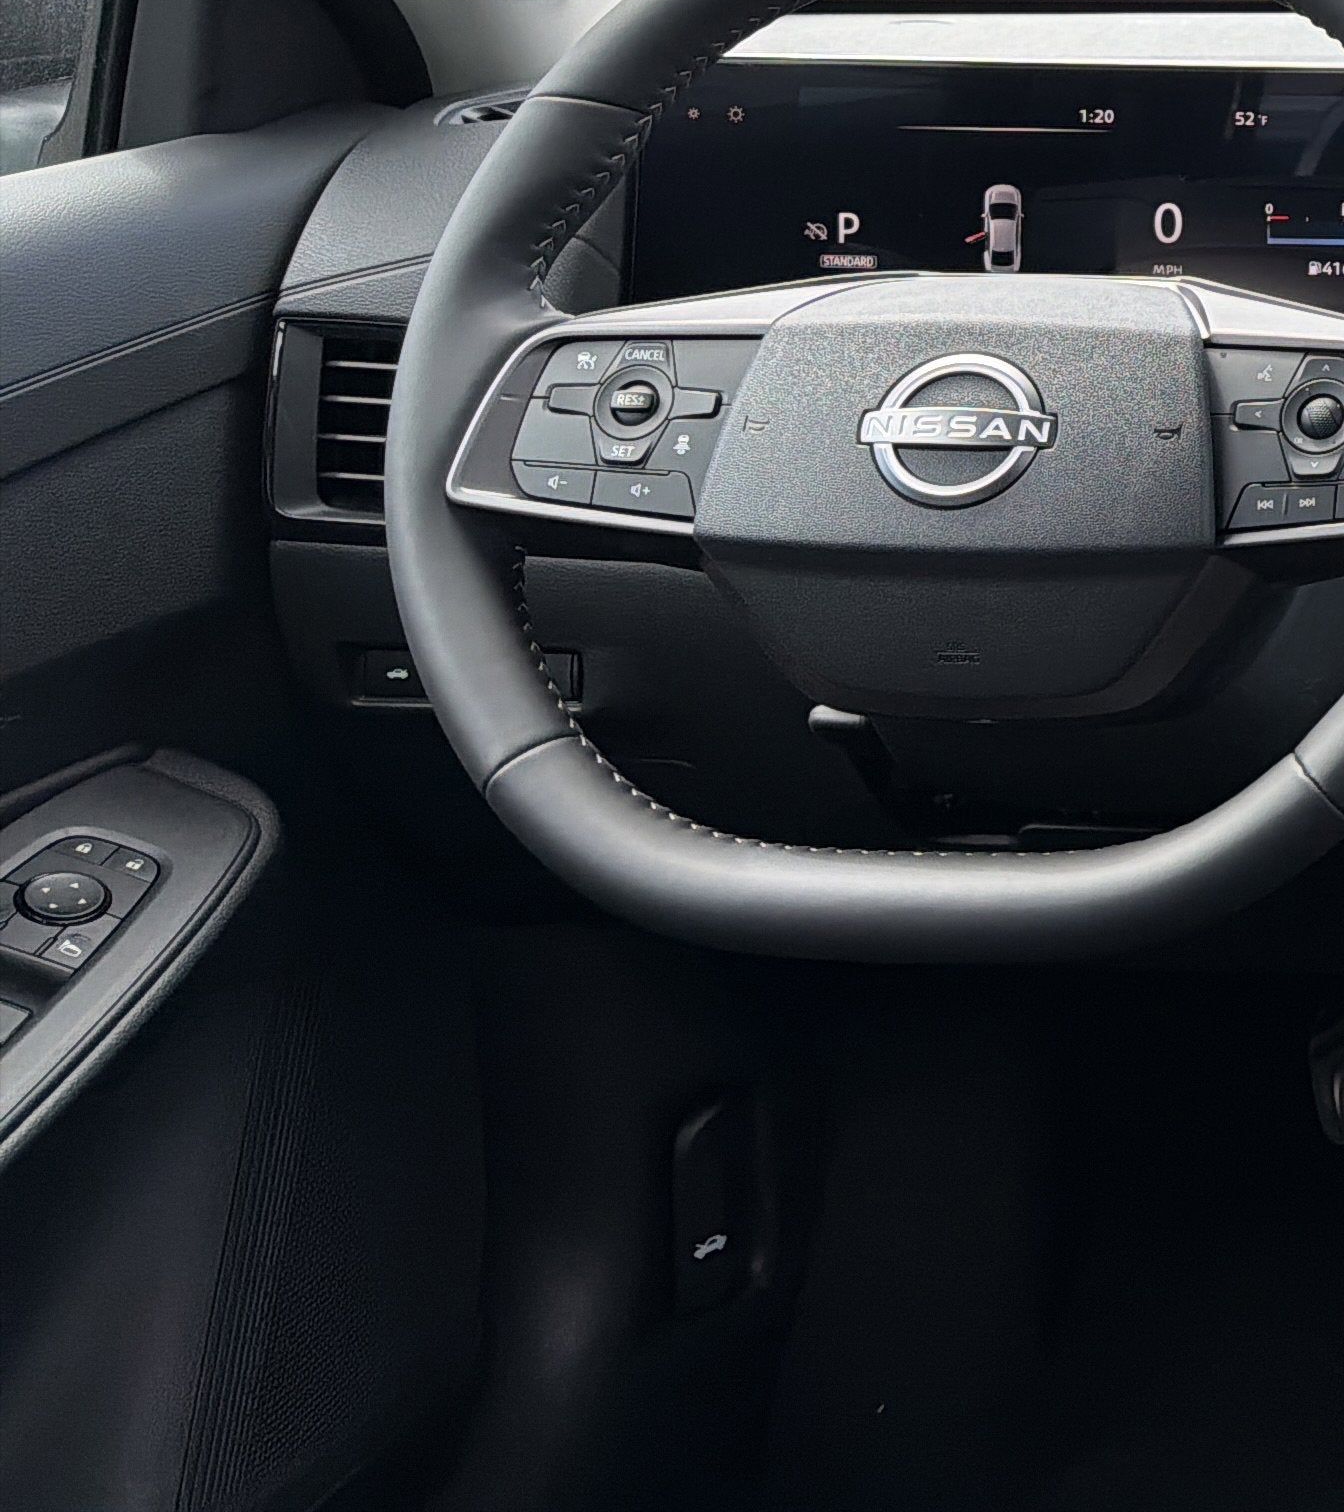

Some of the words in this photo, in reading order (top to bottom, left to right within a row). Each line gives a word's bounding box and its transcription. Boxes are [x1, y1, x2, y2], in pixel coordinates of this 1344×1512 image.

[1079, 109, 1115, 124] 1:20
[1234, 112, 1254, 126] 52
[1264, 203, 1274, 214] 0
[838, 212, 860, 244] P
[1154, 202, 1183, 244] 0
[823, 255, 874, 267] STANDARD
[1153, 264, 1183, 275] MPH
[624, 348, 665, 361] CANCEL
[867, 414, 1050, 443] NISSAN
[611, 445, 636, 457] SET
